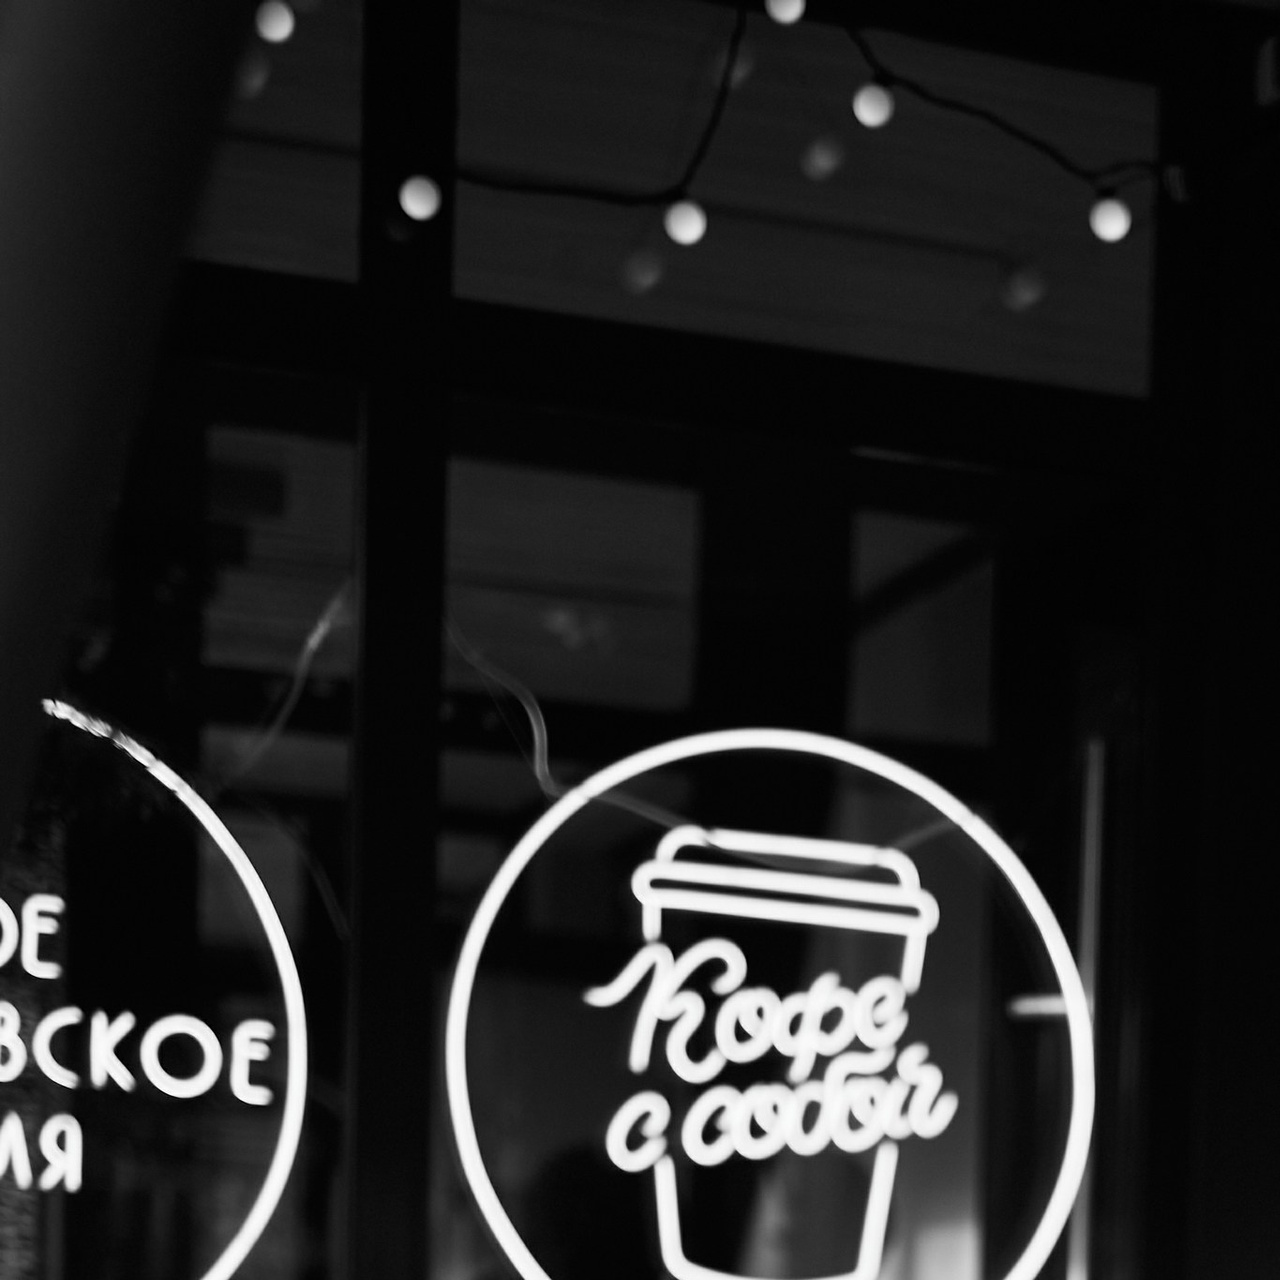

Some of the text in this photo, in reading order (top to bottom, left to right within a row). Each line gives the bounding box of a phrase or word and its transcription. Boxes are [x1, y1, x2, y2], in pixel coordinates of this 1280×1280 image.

[0, 894, 65, 979] Е
[584, 937, 908, 1083] Кофе
[681, 1042, 959, 1166] собой
